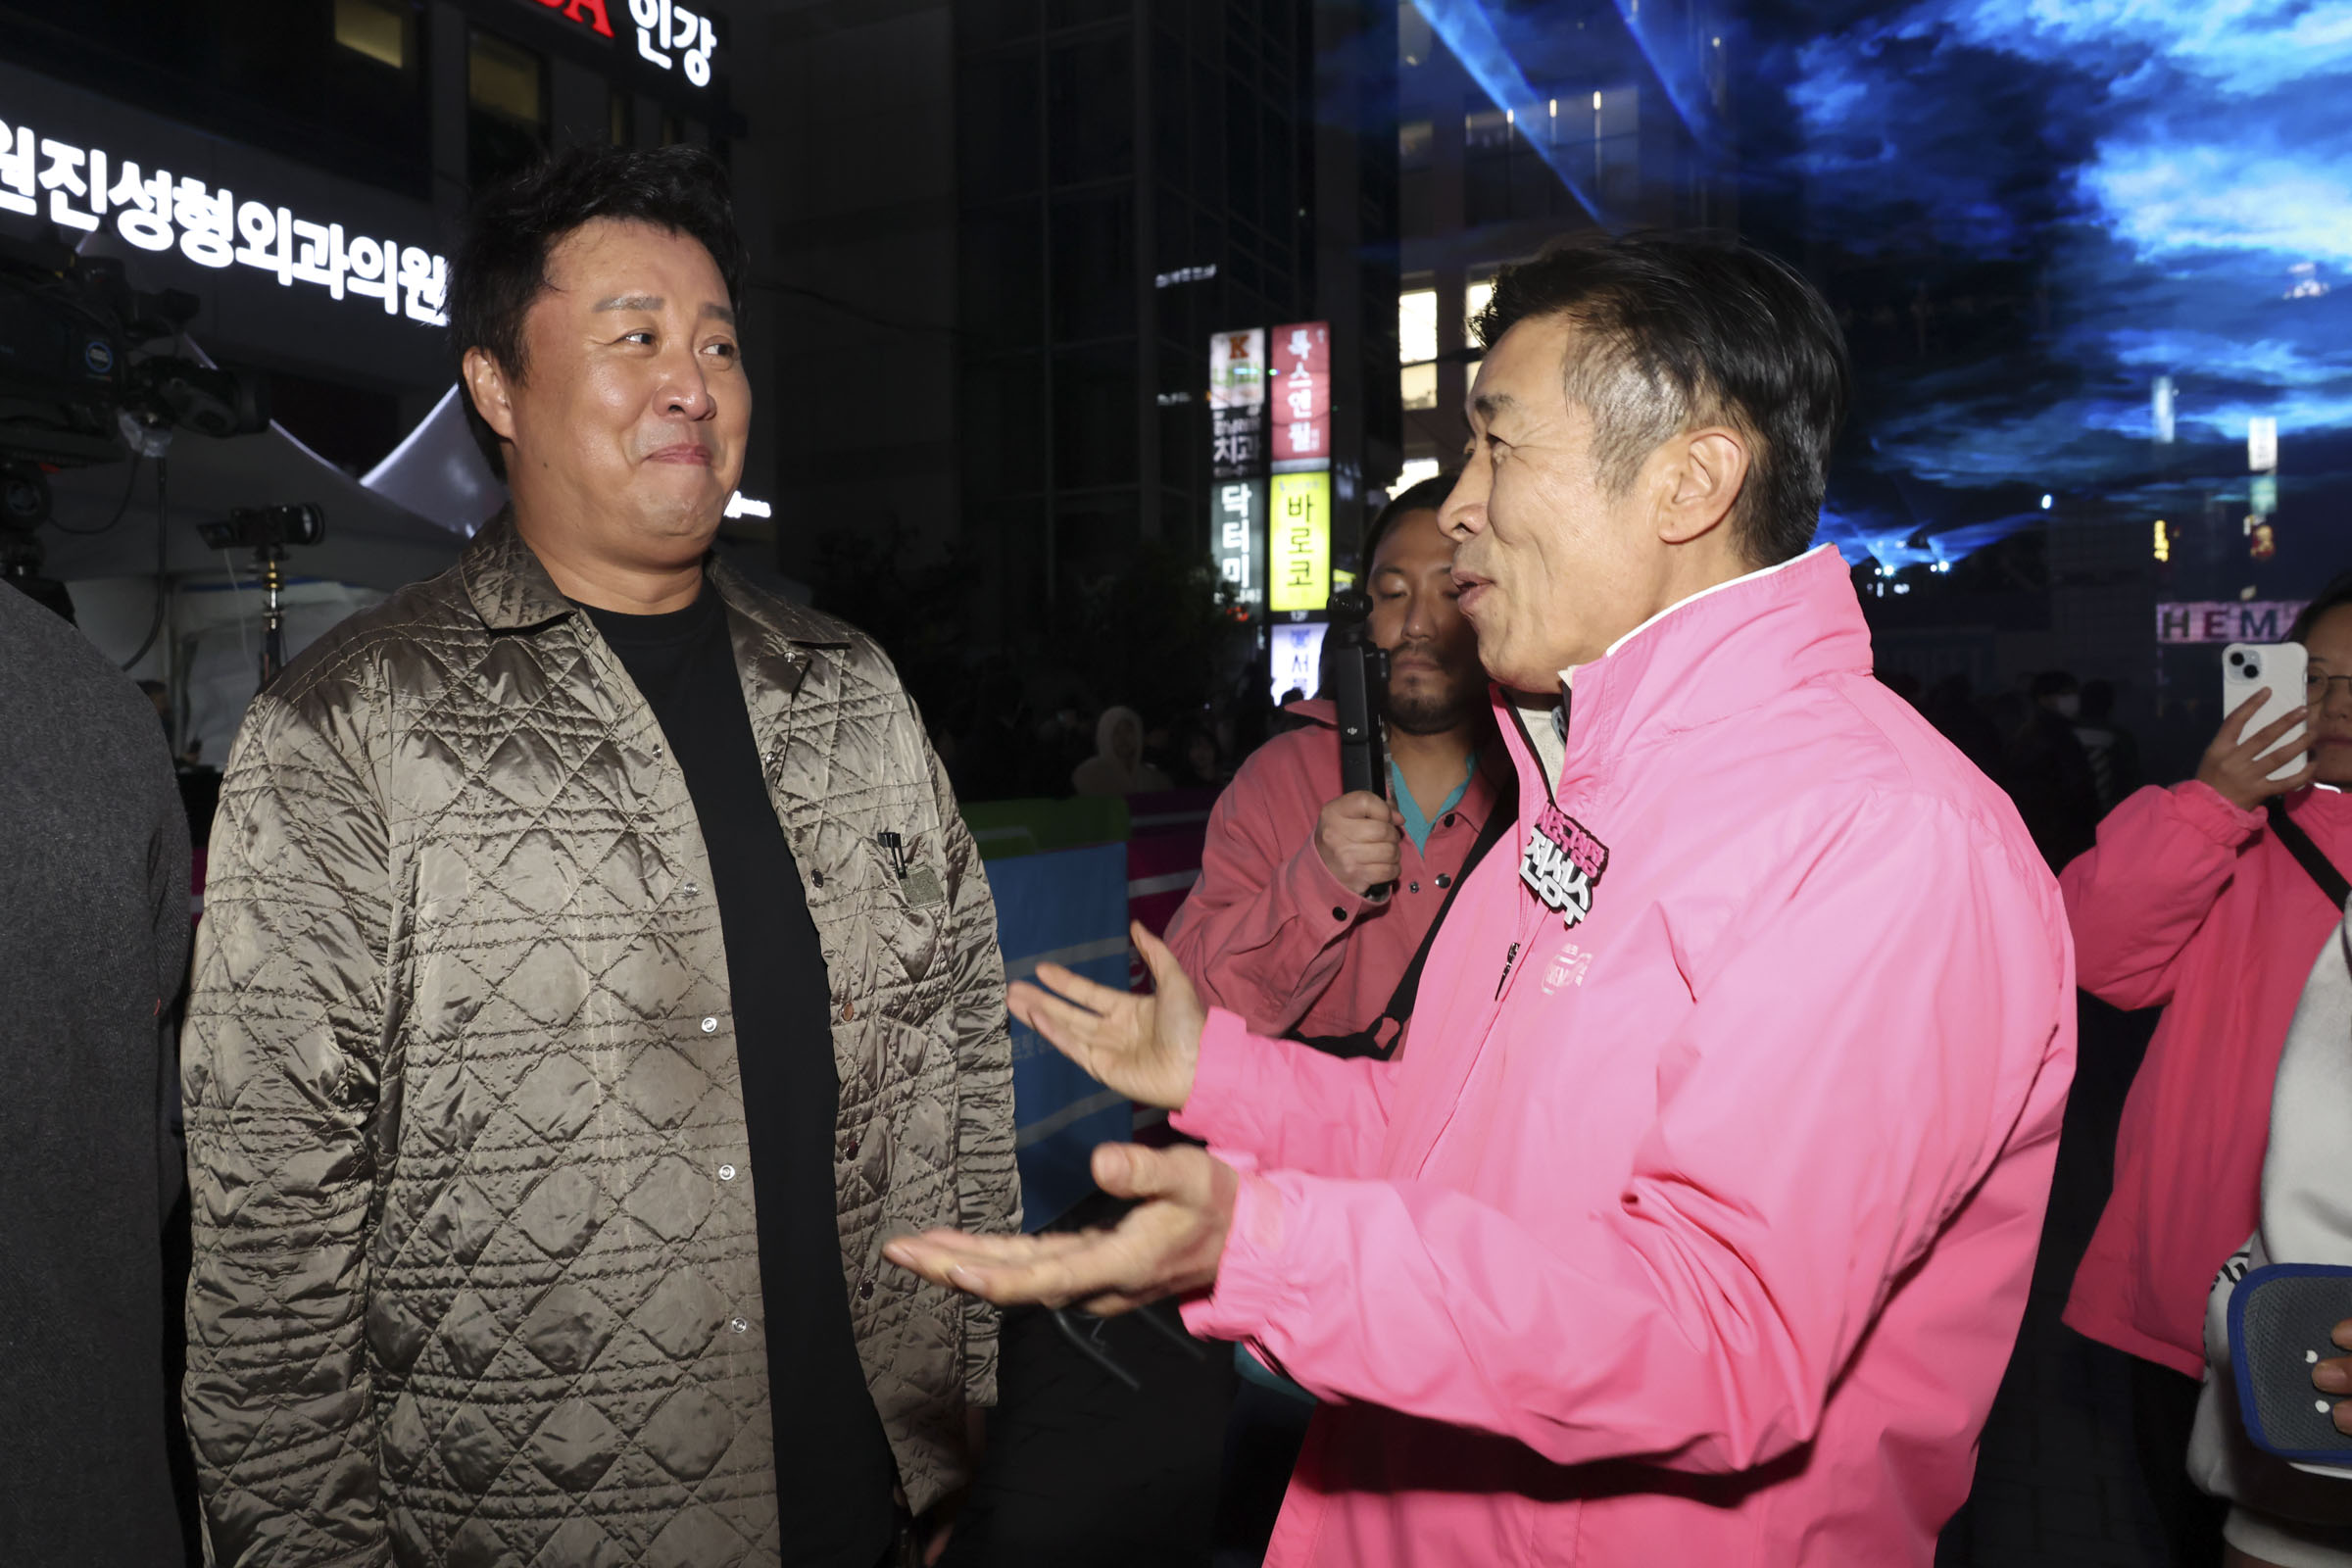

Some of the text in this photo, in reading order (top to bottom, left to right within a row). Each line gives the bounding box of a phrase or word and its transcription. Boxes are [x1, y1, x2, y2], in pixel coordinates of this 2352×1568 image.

[628, 0, 717, 87] 인강
[0, 119, 448, 326] 원진성형외과의원
[1288, 493, 1314, 588] 바로코
